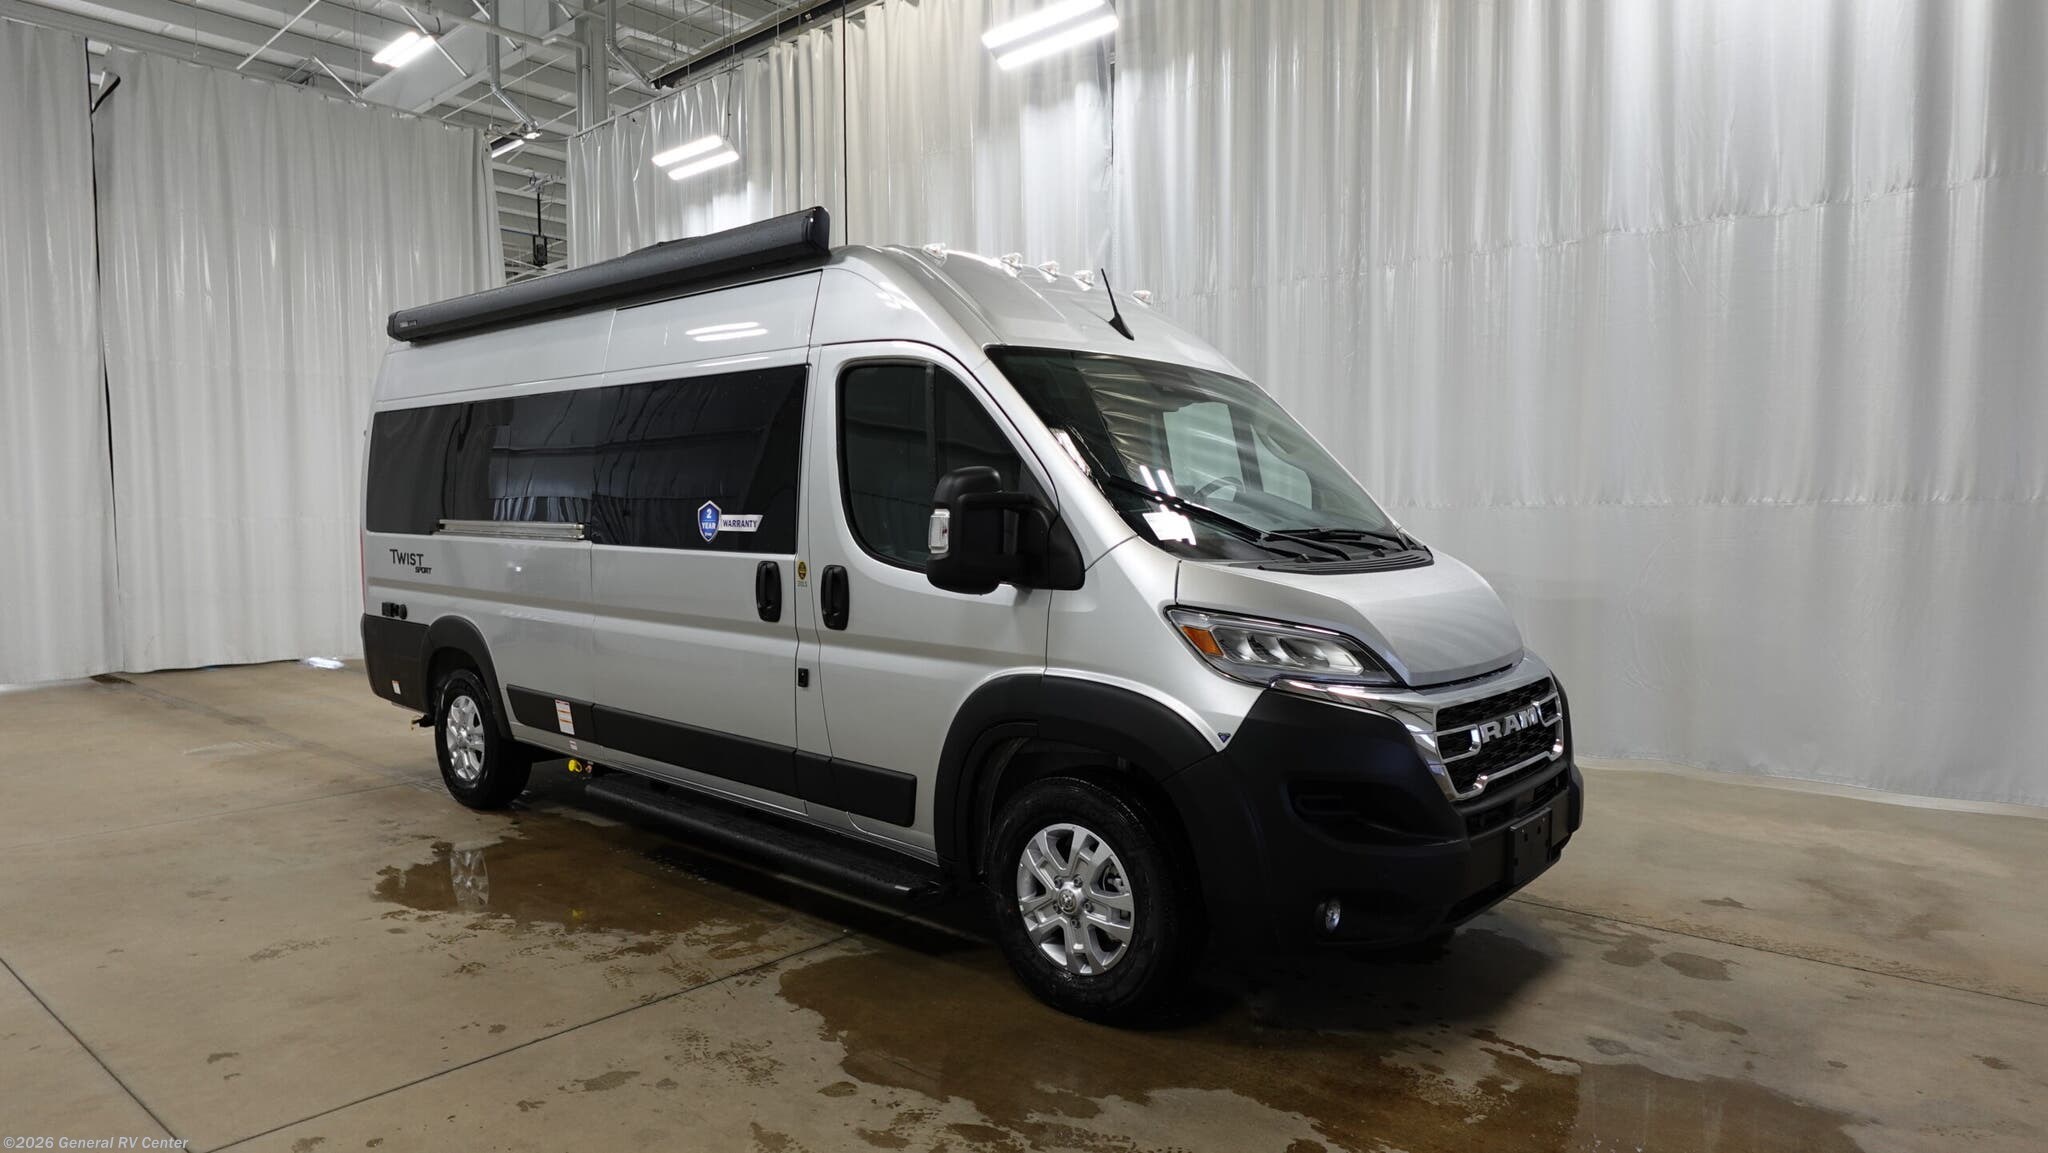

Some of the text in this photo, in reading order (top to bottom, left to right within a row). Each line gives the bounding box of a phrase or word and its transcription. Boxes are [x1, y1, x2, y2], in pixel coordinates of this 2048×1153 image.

[706, 508, 712, 519] 2
[702, 522, 716, 530] YEAR
[723, 520, 758, 528] WARRANTY
[415, 566, 432, 574] SPORT
[1480, 706, 1538, 744] RAM
